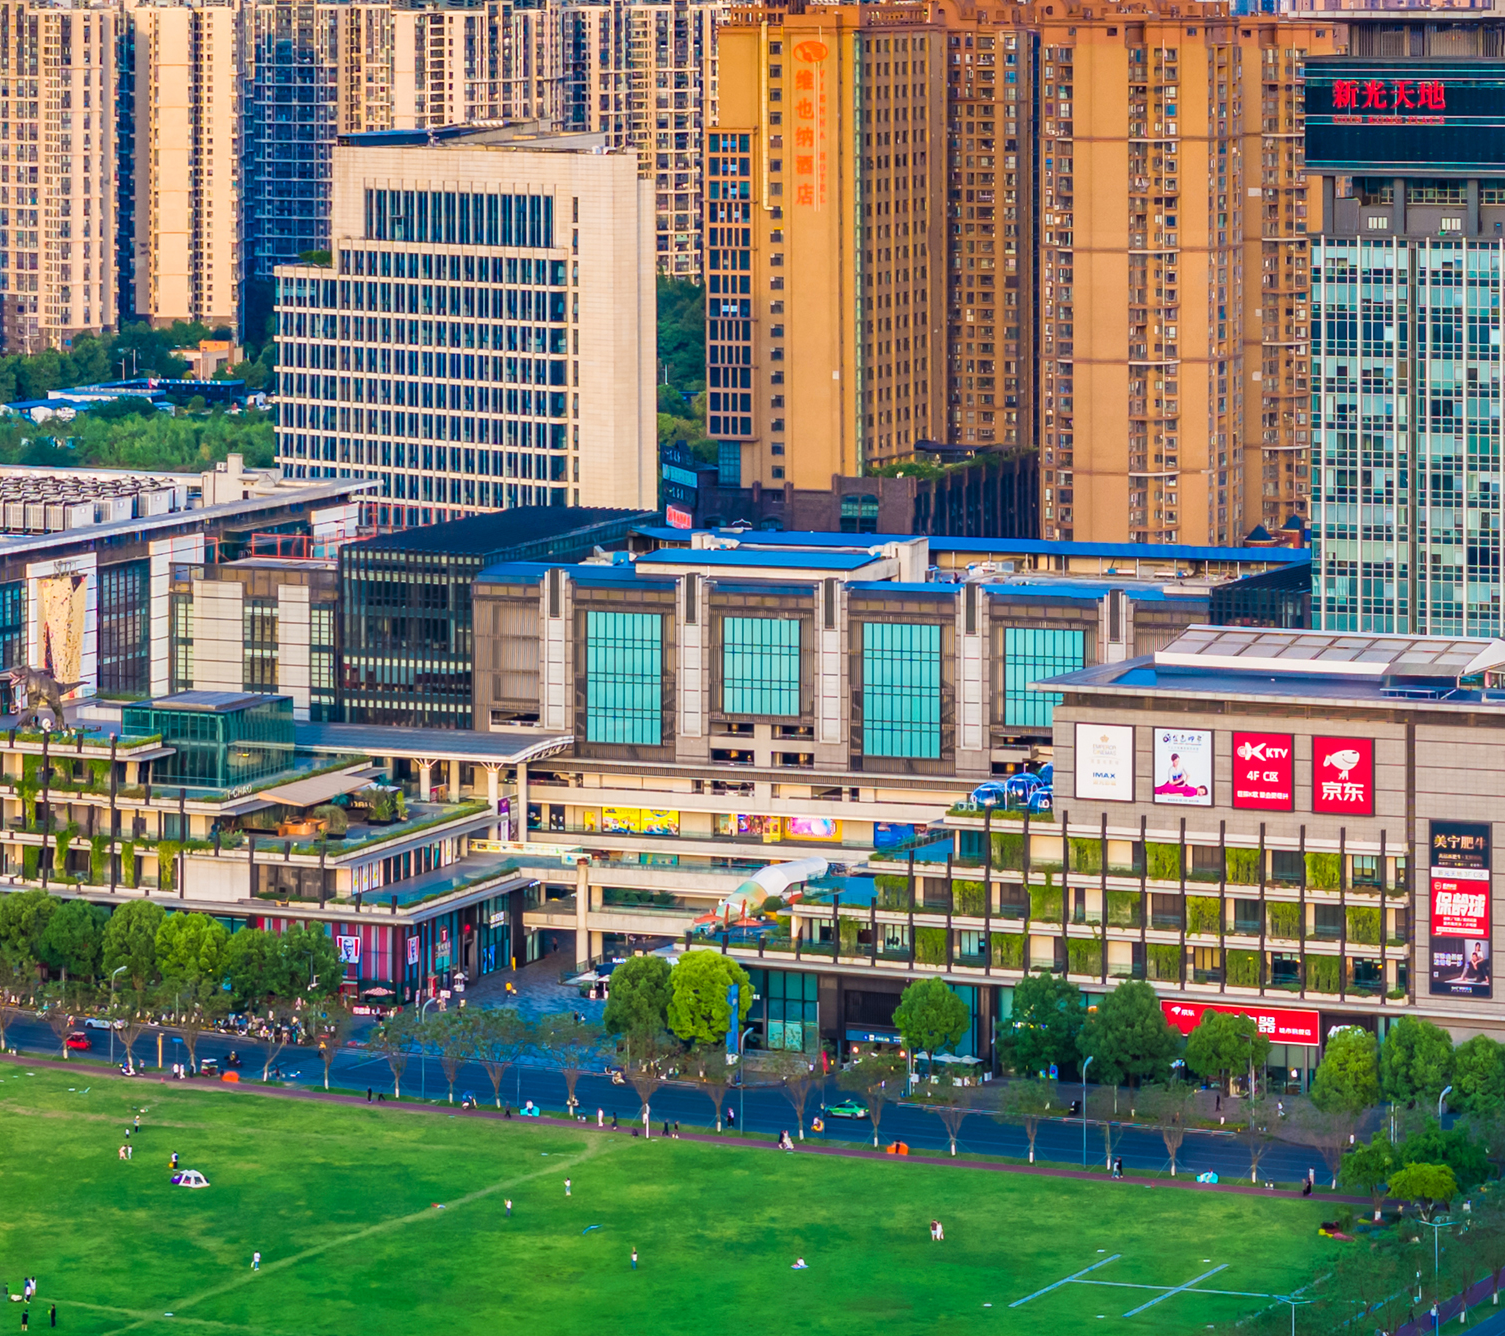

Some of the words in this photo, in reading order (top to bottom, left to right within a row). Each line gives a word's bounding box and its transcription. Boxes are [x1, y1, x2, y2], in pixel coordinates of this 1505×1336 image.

[1332, 79, 1446, 110] 新光天地
[1333, 115, 1362, 124] SHIN
[1367, 115, 1403, 125] KONG
[1405, 116, 1445, 125] PLACE
[795, 70, 814, 206] 维也纳酒店
[1093, 743, 1117, 751] EMPEROR
[1265, 747, 1287, 759] KTV
[1093, 772, 1116, 780] IMAX
[1246, 770, 1260, 781] 4F
[1262, 771, 1279, 783] C区
[226, 784, 252, 800] T-CHAO
[1321, 781, 1365, 802] 京东
[1434, 834, 1486, 851] 美宁肥牛
[1435, 891, 1486, 918] 保龄球
[1180, 1009, 1195, 1017] 京东
